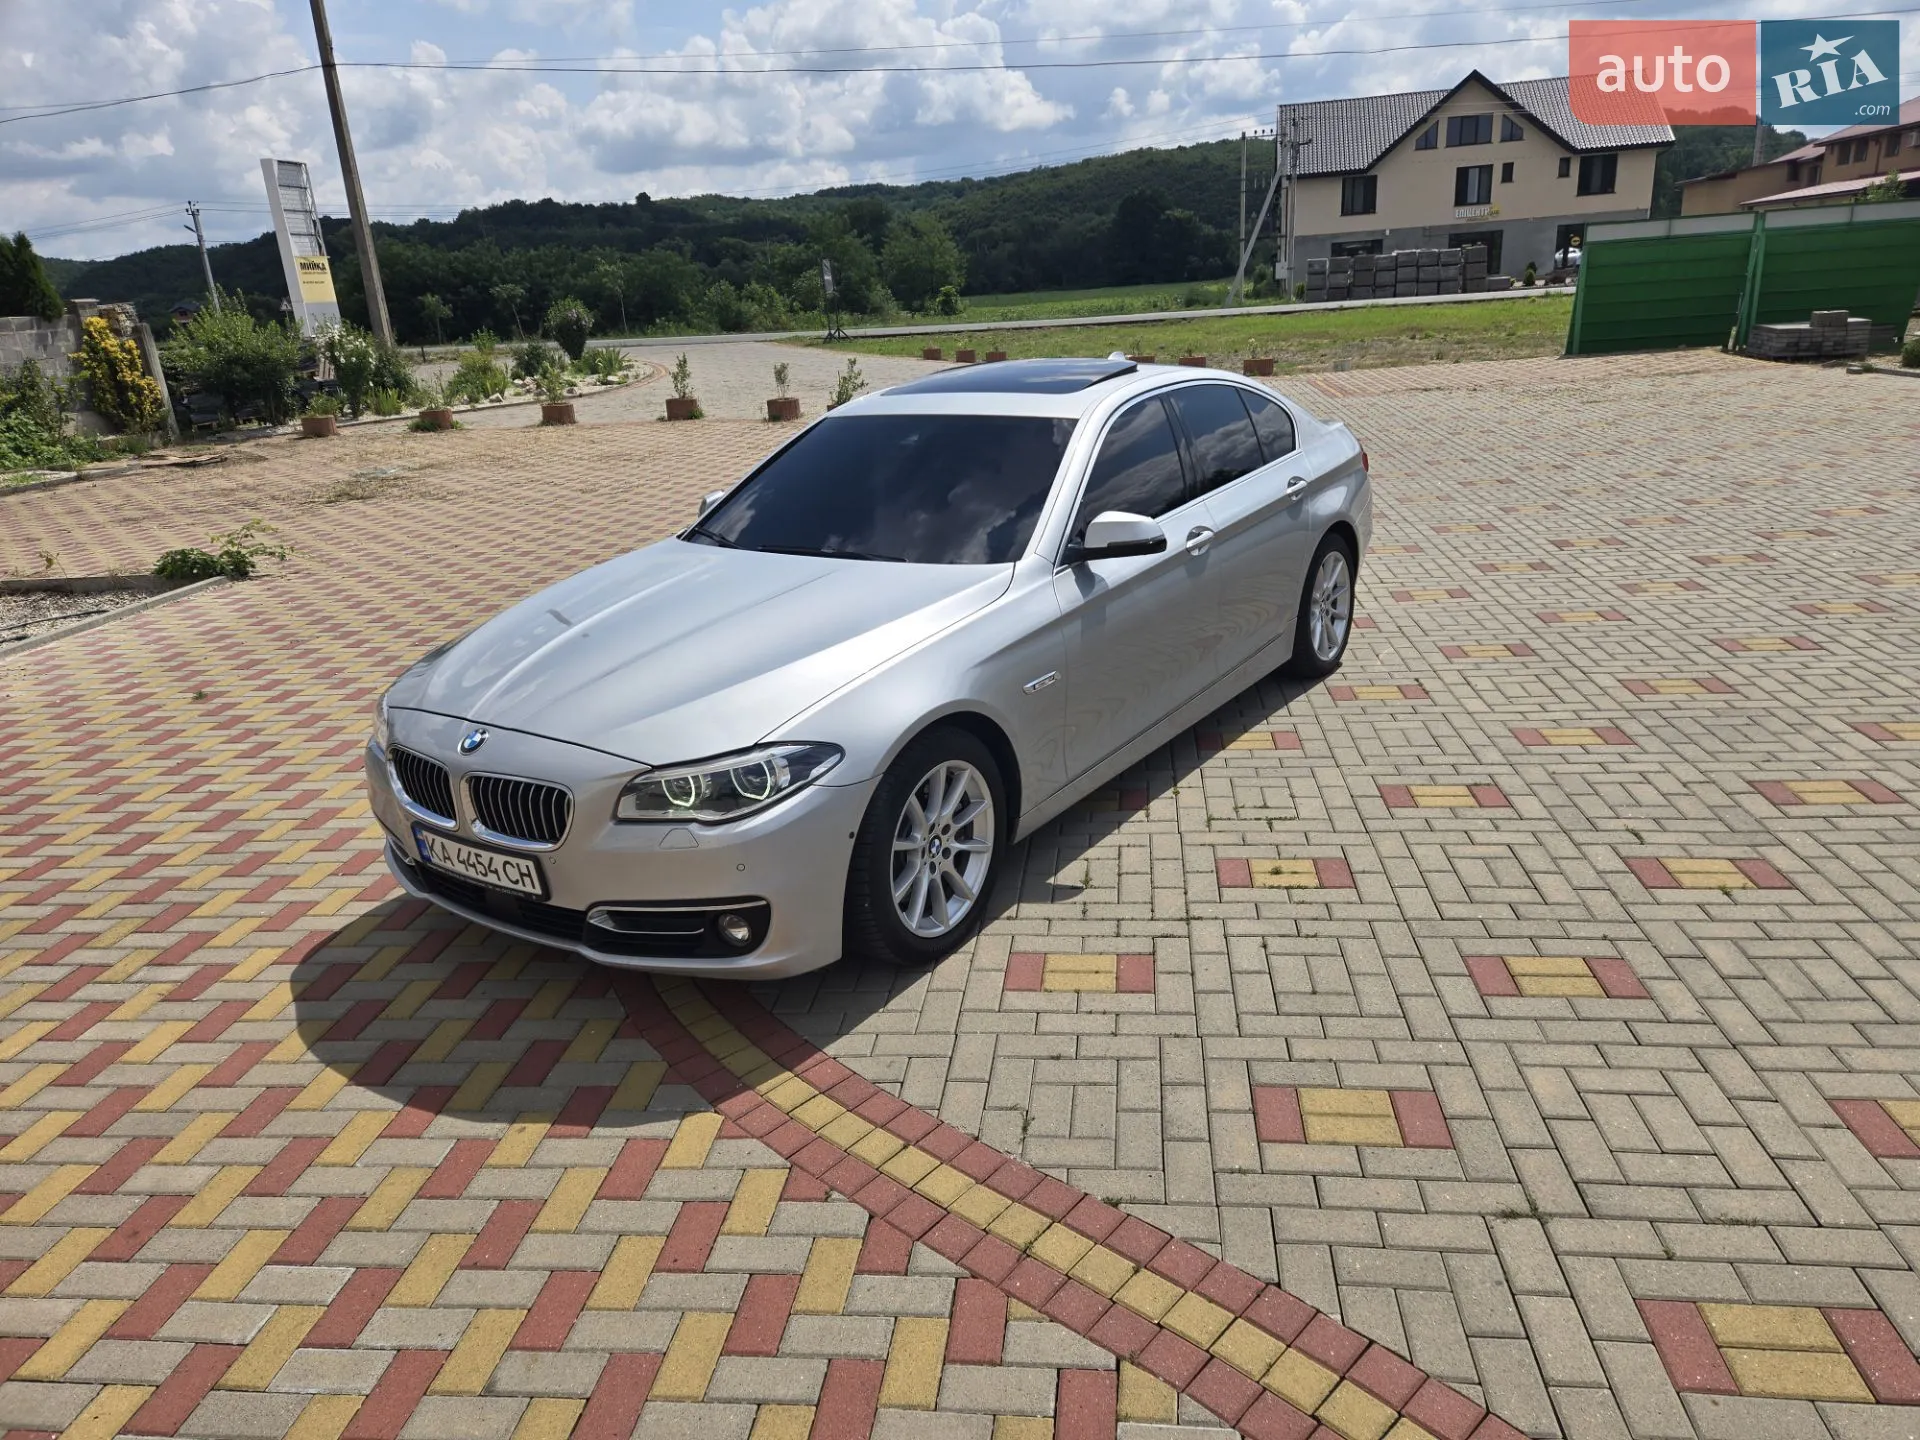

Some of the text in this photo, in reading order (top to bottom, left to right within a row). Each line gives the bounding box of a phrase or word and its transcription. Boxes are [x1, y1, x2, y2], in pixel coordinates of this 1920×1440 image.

[425, 836, 536, 890] KA 4454 CH
